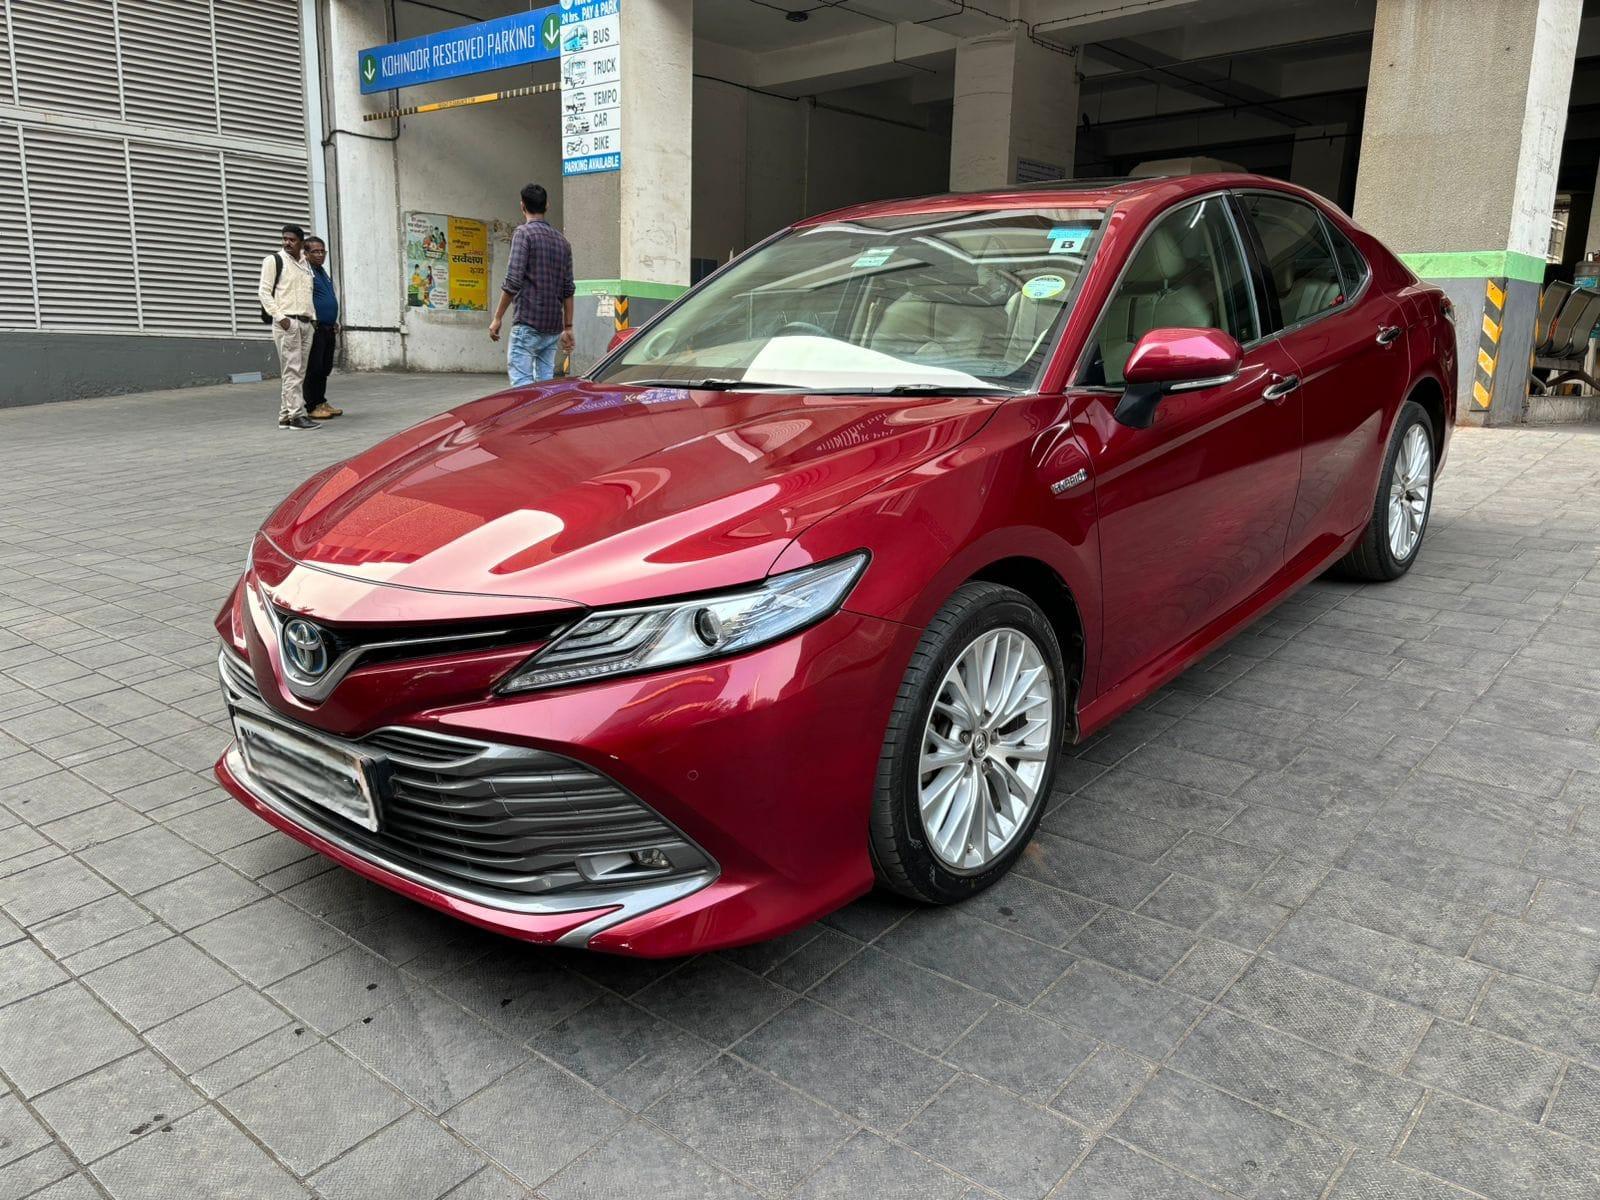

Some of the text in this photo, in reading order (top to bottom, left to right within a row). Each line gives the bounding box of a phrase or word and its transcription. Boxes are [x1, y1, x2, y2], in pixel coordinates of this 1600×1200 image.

[582, 5, 593, 20] PAY
[600, 0, 618, 16] PARK
[593, 27, 610, 44] BUS
[381, 24, 535, 78] KOHINOOR RESERVED PARKING
[593, 57, 616, 76] TRUCK
[593, 88, 617, 106] TEMPO
[593, 112, 608, 127] CAR
[593, 135, 610, 150] BIKE
[564, 154, 619, 173] PARKING AVAILABLE
[1060, 240, 1075, 249] B
